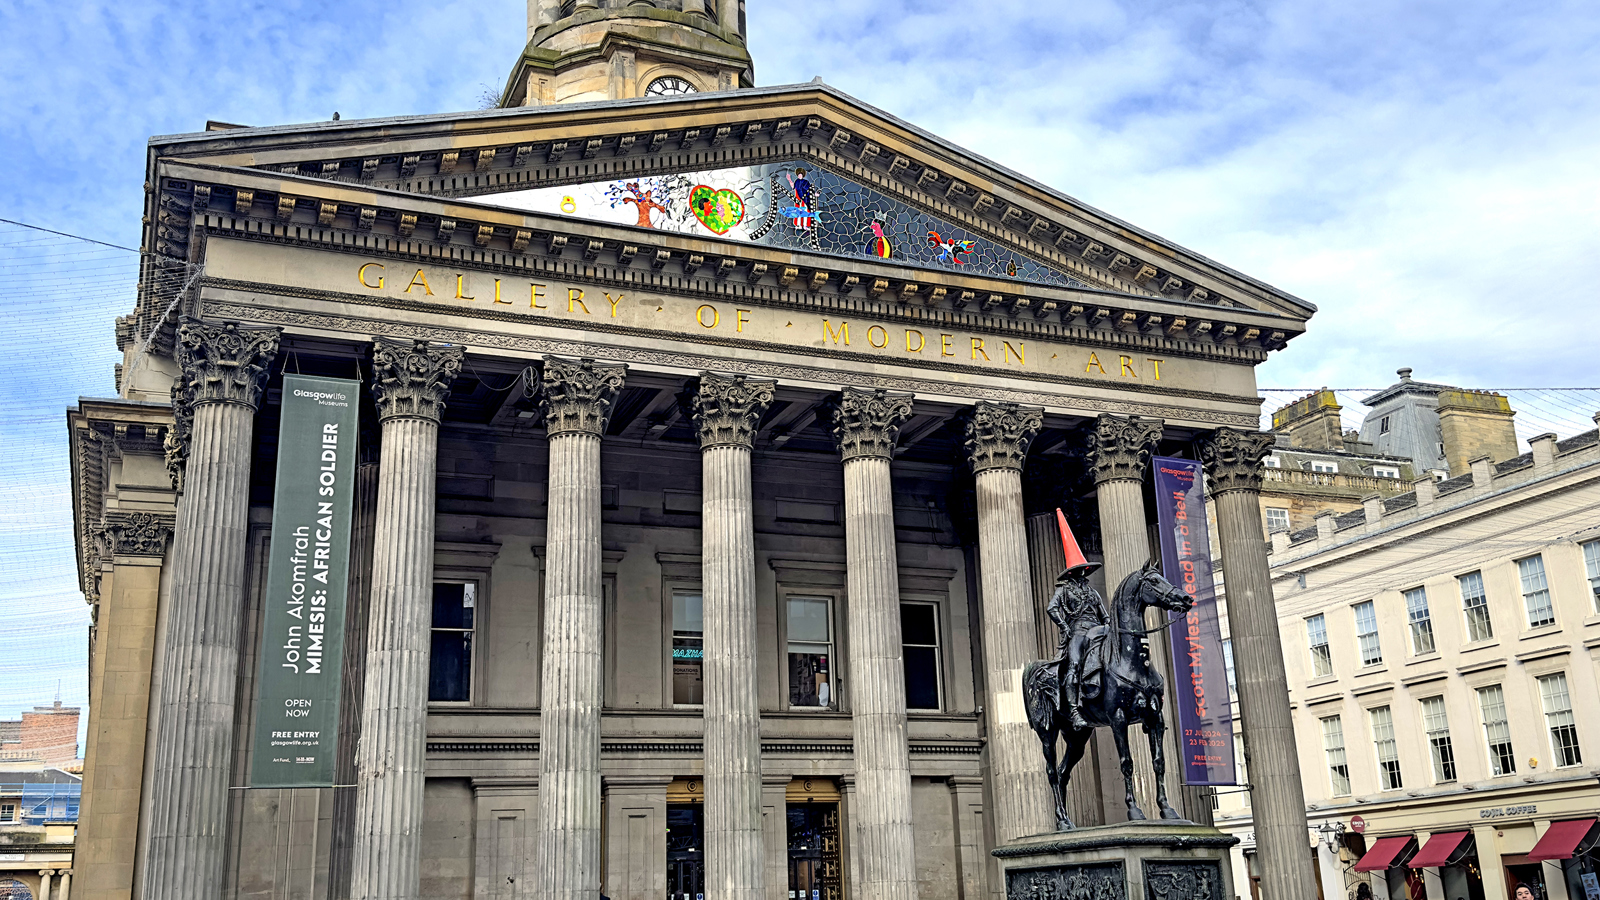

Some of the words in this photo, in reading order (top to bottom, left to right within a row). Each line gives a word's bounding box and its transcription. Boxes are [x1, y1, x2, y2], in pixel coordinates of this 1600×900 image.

[358, 262, 624, 318] GALLERY
[695, 304, 753, 333] OF
[822, 318, 1025, 366] MODERN
[1086, 351, 1165, 381] ART
[293, 389, 346, 400] Glasgowlife
[319, 423, 338, 497] SOLDIER
[1173, 492, 1188, 520] Bell
[312, 502, 333, 585] AFRICAN
[1179, 541, 1192, 556] in
[1180, 525, 1189, 536] a
[287, 526, 309, 620] Akomfrah
[282, 625, 301, 674] John
[305, 589, 327, 674] MIMESIS:
[1185, 611, 1205, 667] Myles:
[285, 699, 312, 707] OPEN
[285, 709, 310, 717] NOW
[1191, 672, 1206, 718] Scott
[1506, 805, 1537, 816] COFFEE
